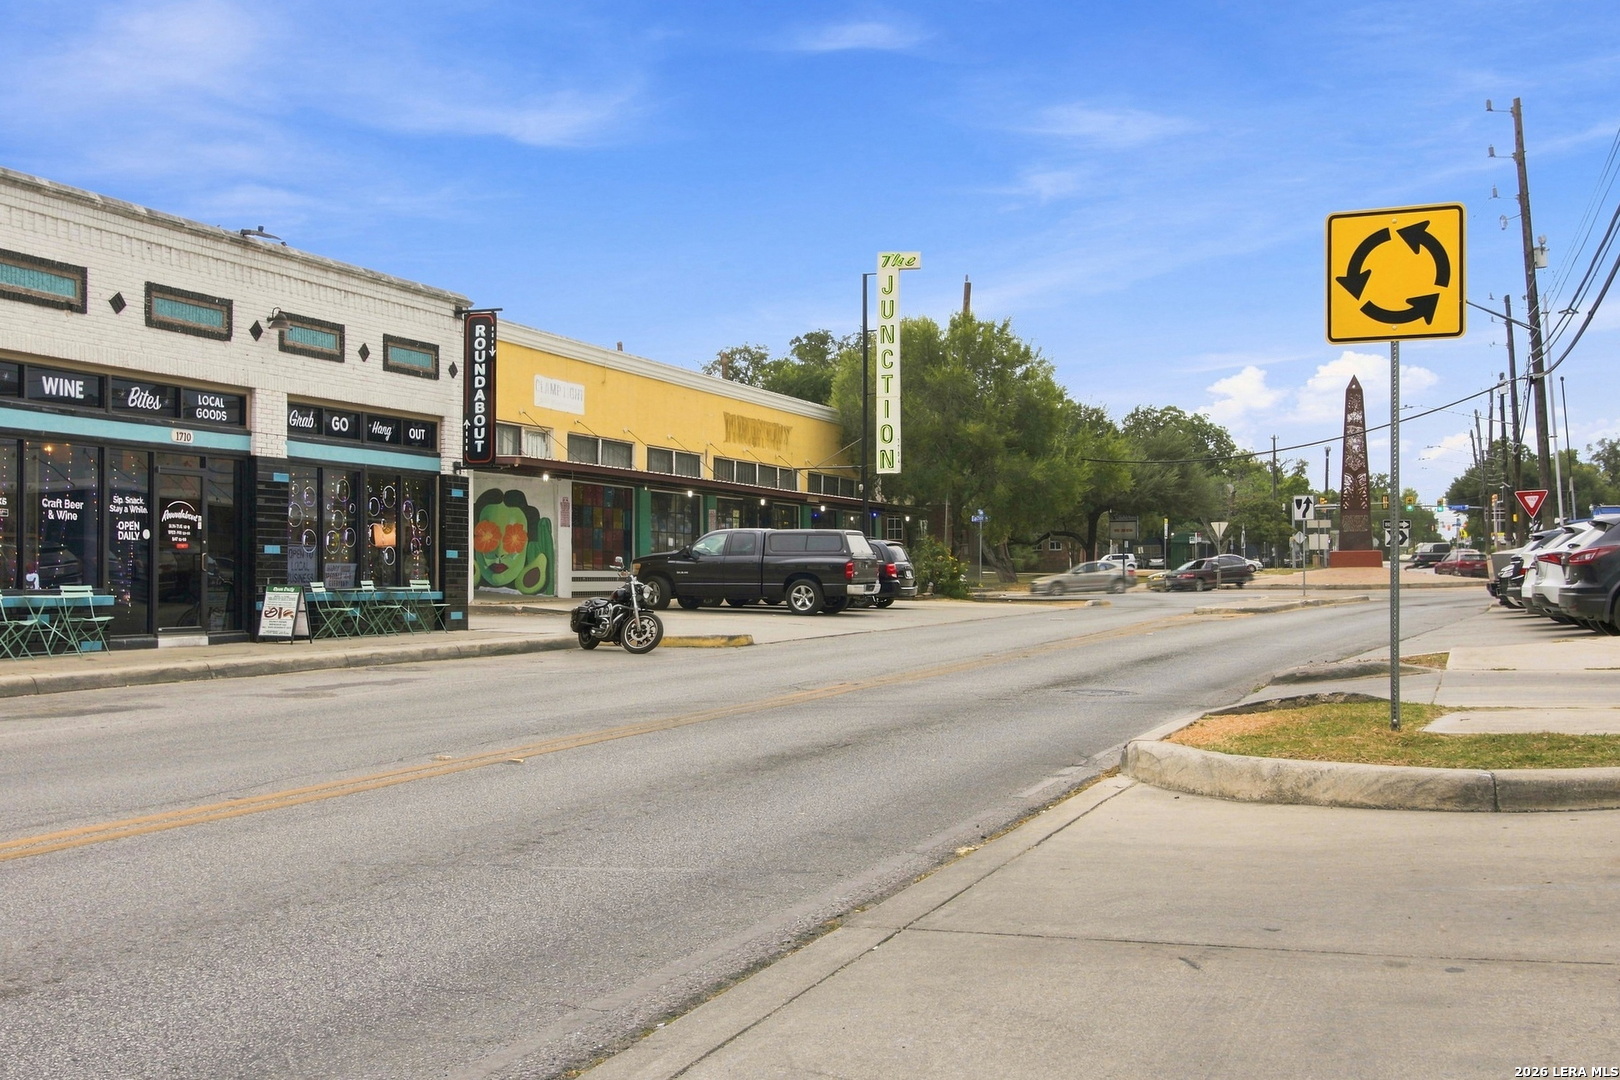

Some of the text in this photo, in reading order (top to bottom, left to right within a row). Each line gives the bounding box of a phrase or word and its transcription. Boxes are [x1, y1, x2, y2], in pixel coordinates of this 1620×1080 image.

[881, 253, 916, 268] The
[880, 275, 895, 469] JUNCTION
[41, 375, 84, 399] WINE
[473, 324, 487, 453] ROUNDABOUT
[127, 386, 162, 410] Bites
[198, 394, 225, 408] LOCAL
[196, 408, 227, 422] GOODS
[289, 409, 314, 429] Grab
[331, 416, 349, 432] GO
[371, 420, 393, 442] Hang
[175, 430, 192, 442] 1710
[408, 428, 426, 441] OUT
[41, 498, 84, 510] Craft Beer
[109, 504, 123, 514] Stay
[47, 509, 78, 521] & Wine
[118, 520, 140, 531] OPEN
[117, 531, 140, 541] DAILY
